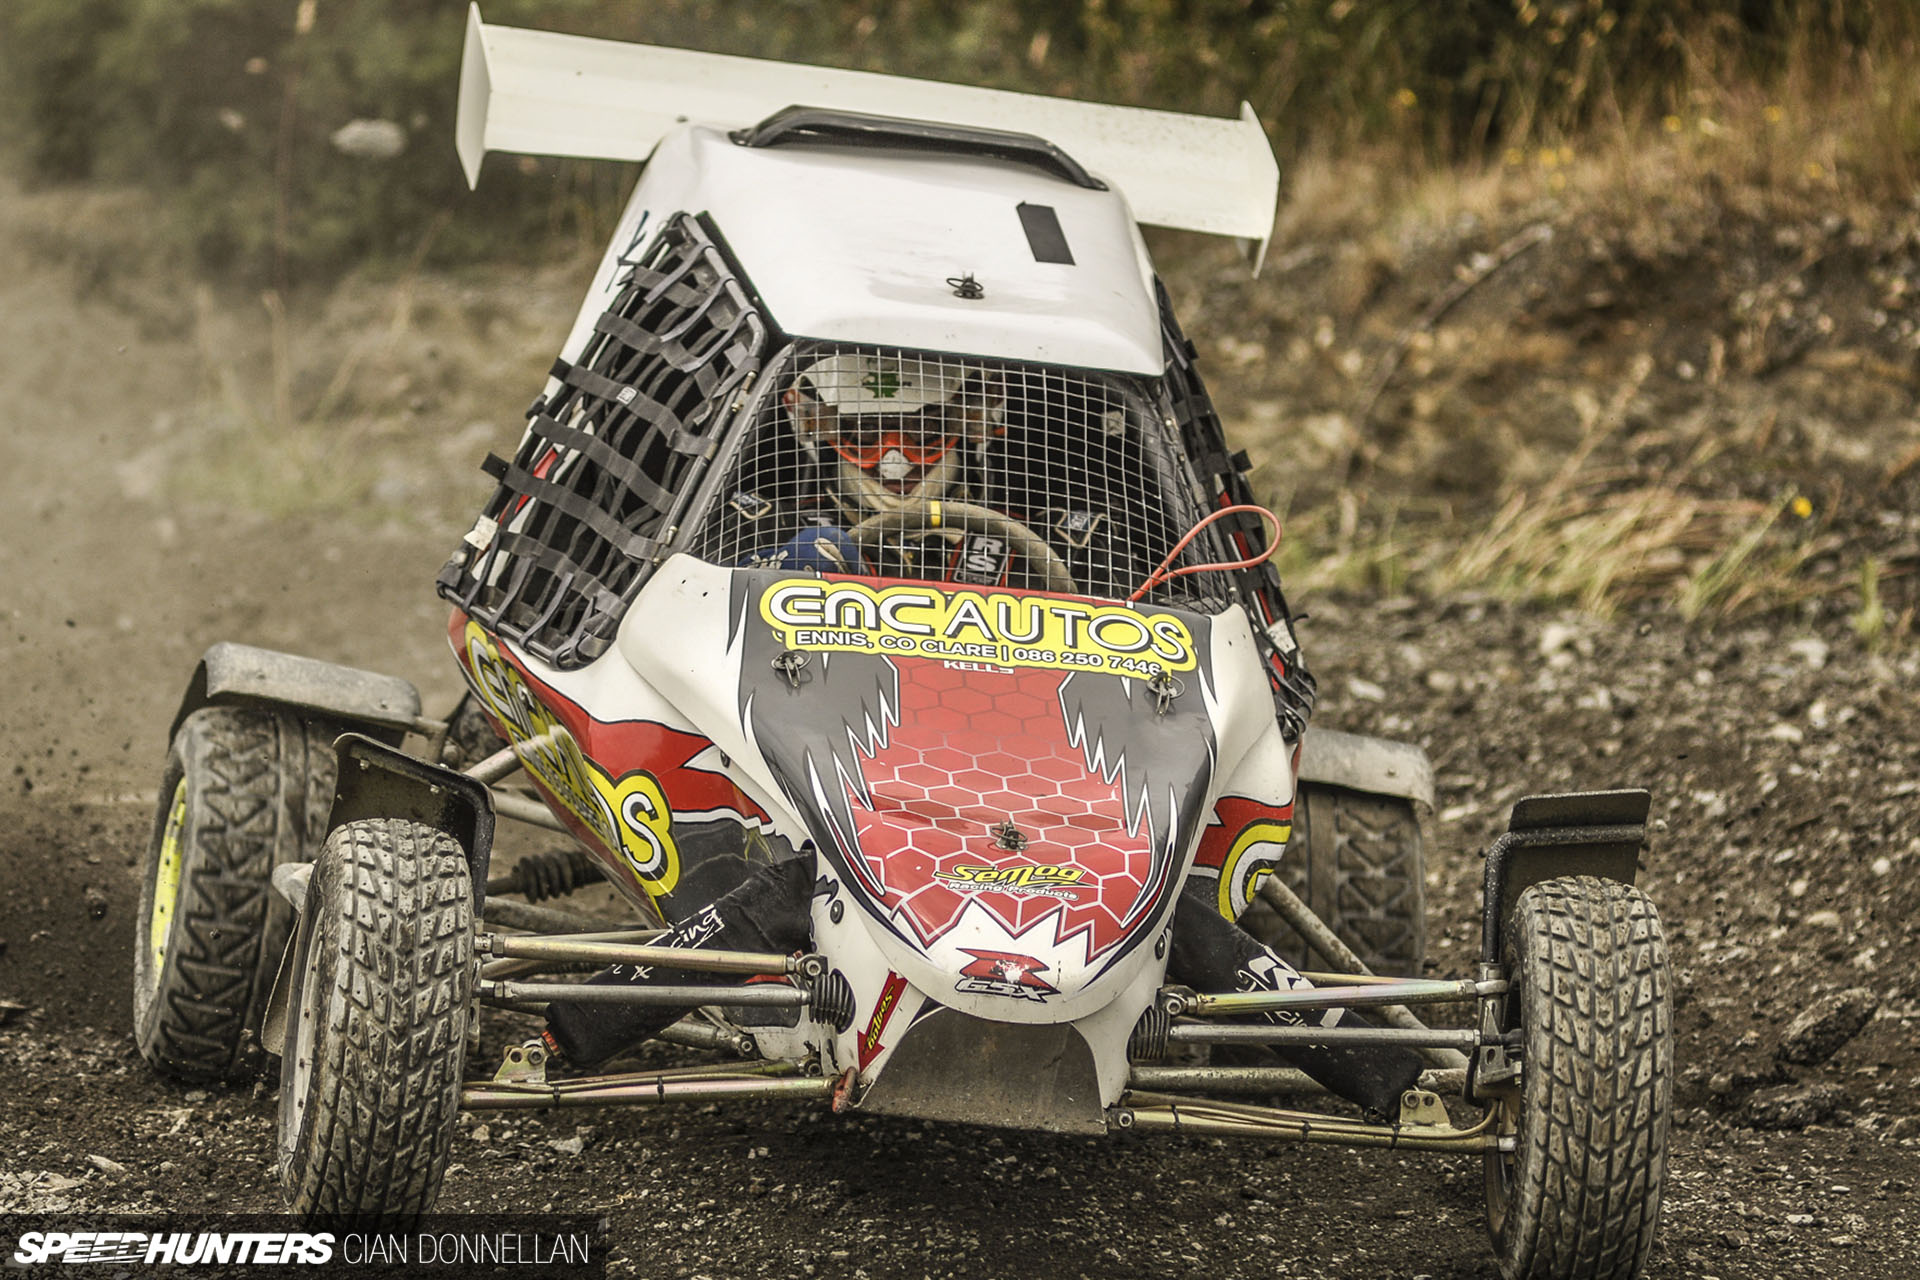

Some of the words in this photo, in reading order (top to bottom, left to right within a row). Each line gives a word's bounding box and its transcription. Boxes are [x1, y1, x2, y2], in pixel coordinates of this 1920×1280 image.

[769, 586, 936, 635] EMC
[943, 599, 1189, 664] AUTOS
[795, 630, 875, 649] ENNIS,
[879, 636, 917, 651] CO
[920, 638, 998, 658] CLARE
[1012, 648, 1057, 663] 086
[1061, 652, 1104, 667] 250
[1107, 655, 1164, 677] 7446
[949, 881, 1004, 893] Racing
[1008, 886, 1080, 901] Products
[954, 978, 1060, 1003] GSX
